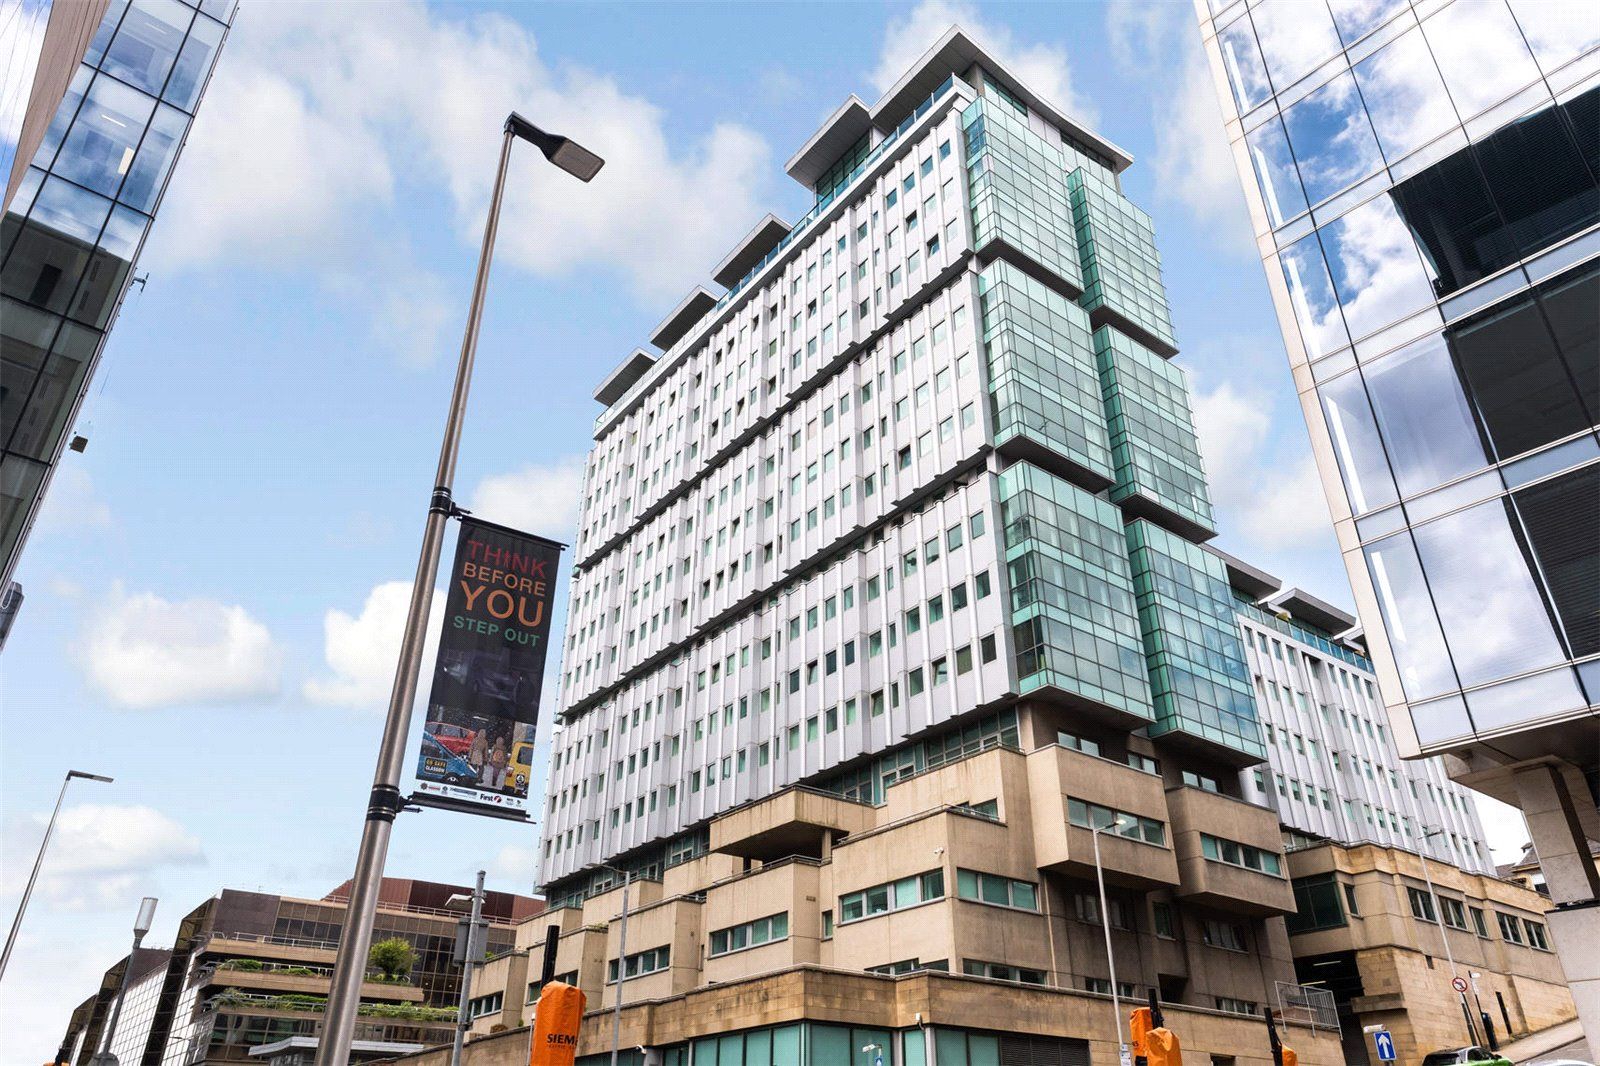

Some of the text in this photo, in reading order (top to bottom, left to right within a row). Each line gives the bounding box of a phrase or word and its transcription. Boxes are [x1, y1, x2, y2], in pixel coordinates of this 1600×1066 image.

[468, 540, 547, 577] THINK
[463, 561, 546, 596] BEFORE
[460, 580, 543, 627] YOU
[453, 615, 540, 647] STEP OUT
[480, 793, 493, 802] First
